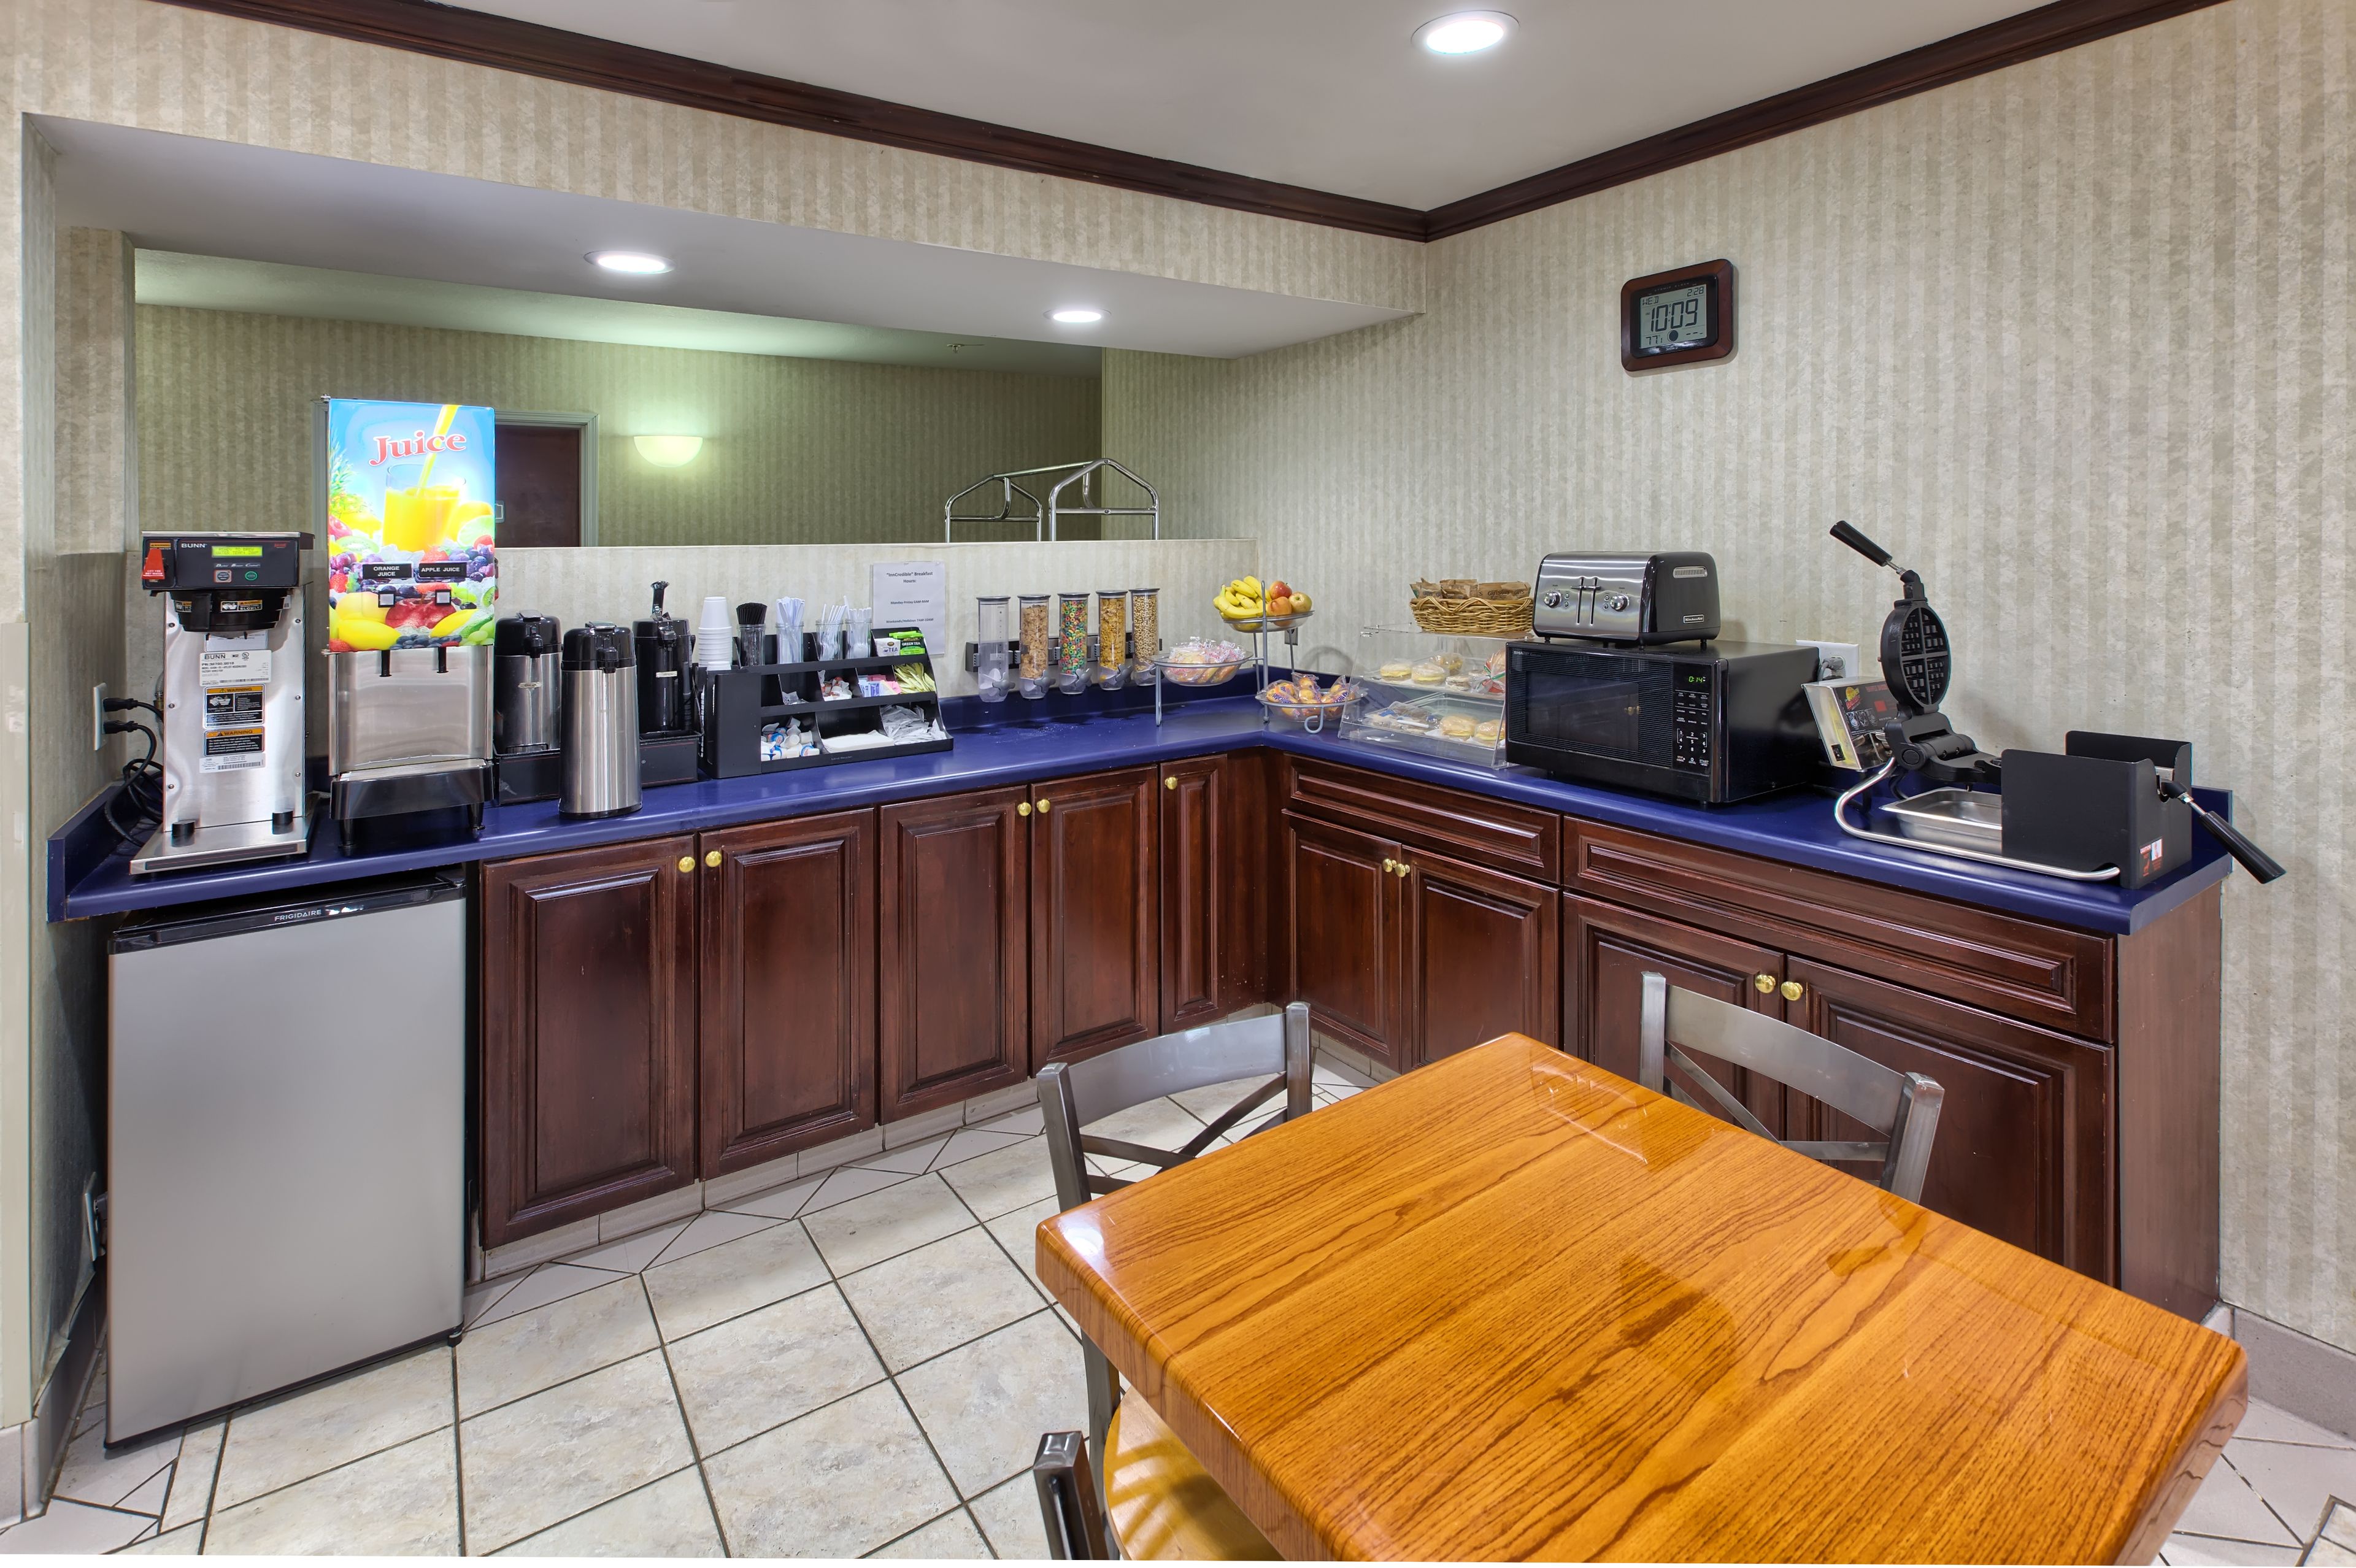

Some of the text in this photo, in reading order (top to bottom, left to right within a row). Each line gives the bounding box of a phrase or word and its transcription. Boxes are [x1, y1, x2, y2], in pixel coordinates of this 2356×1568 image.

[1642, 296, 1659, 306] WED
[1650, 298, 1698, 332] 10:09
[369, 430, 466, 466] Juice
[274, 909, 321, 921] FRIGIDAIRE
